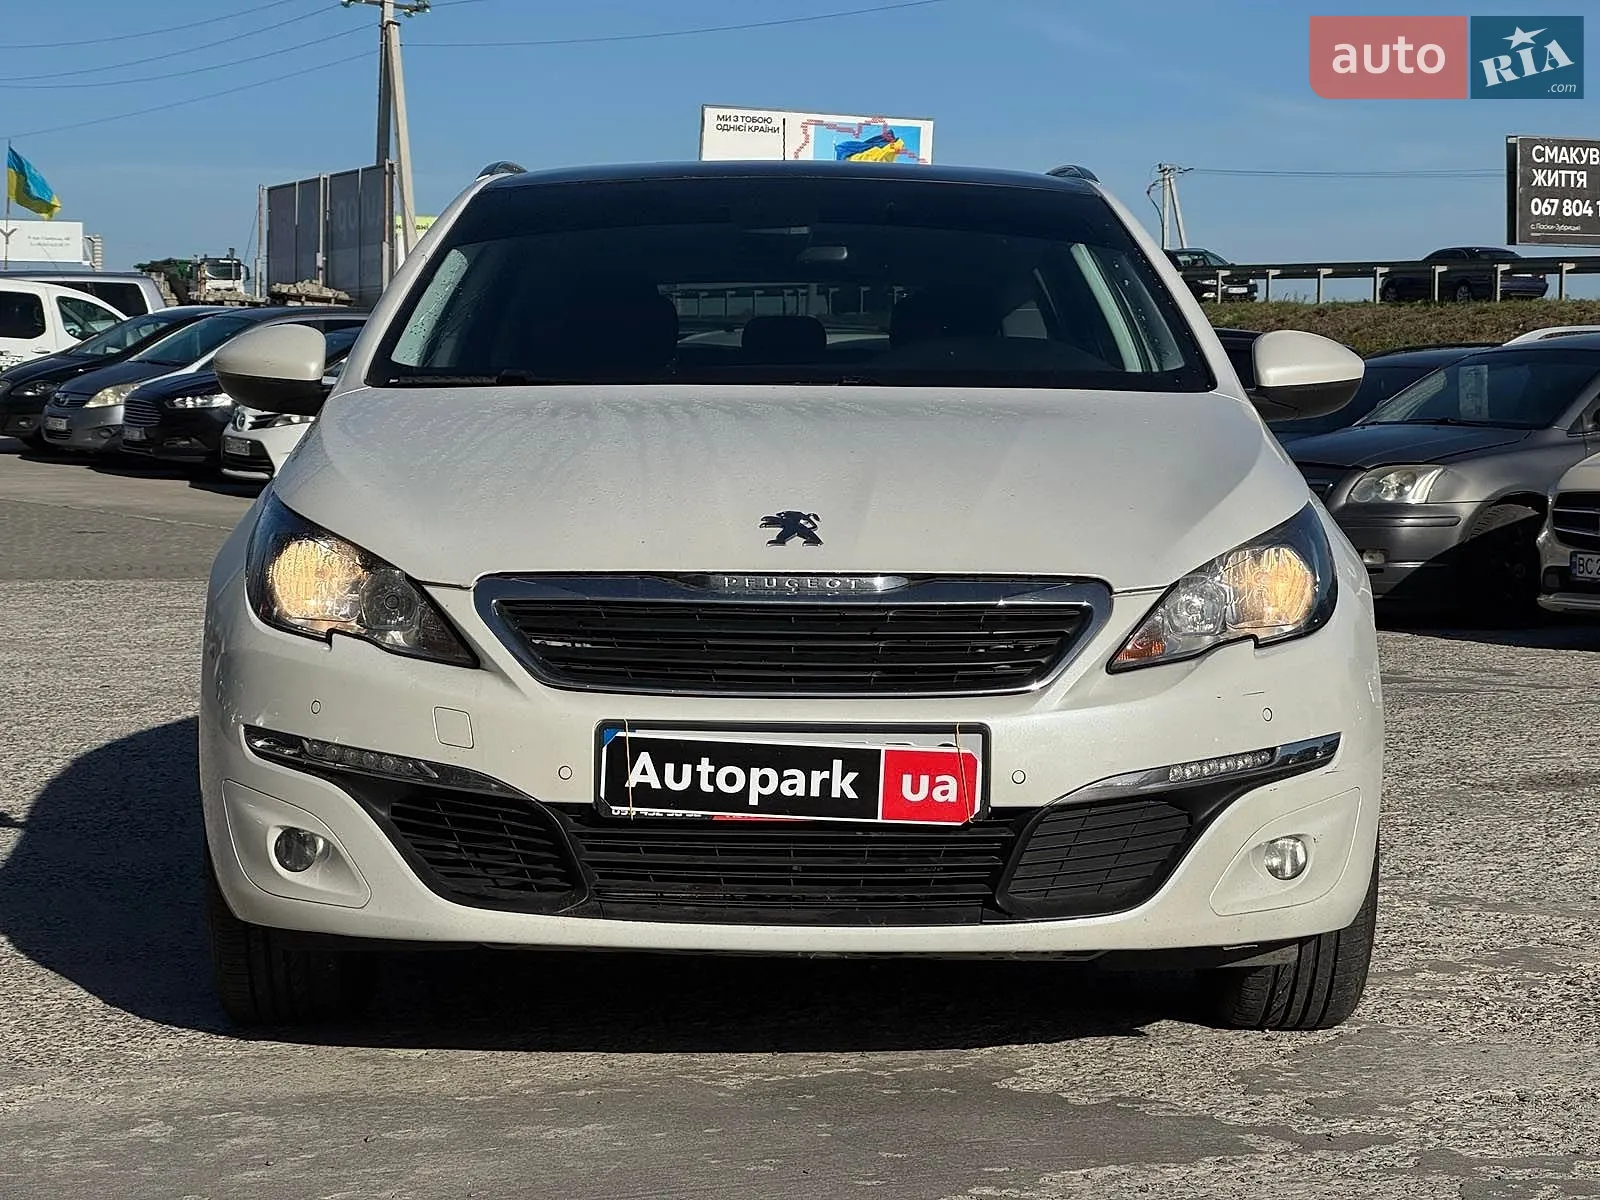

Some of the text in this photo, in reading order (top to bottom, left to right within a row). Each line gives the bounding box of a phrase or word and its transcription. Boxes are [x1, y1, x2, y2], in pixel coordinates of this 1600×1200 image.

[716, 114, 731, 122] МИ
[740, 116, 773, 124] ТОБОЮ
[716, 123, 780, 133] ОДНІЄЇ КРАЇНИ
[1531, 144, 1600, 165] СМАКУВ
[1531, 168, 1587, 188] ЖИТТЯ
[1530, 197, 1559, 216] 067
[1562, 199, 1593, 217] 804
[724, 576, 861, 589] PEUGEOT
[625, 751, 957, 805] Autopark ua
